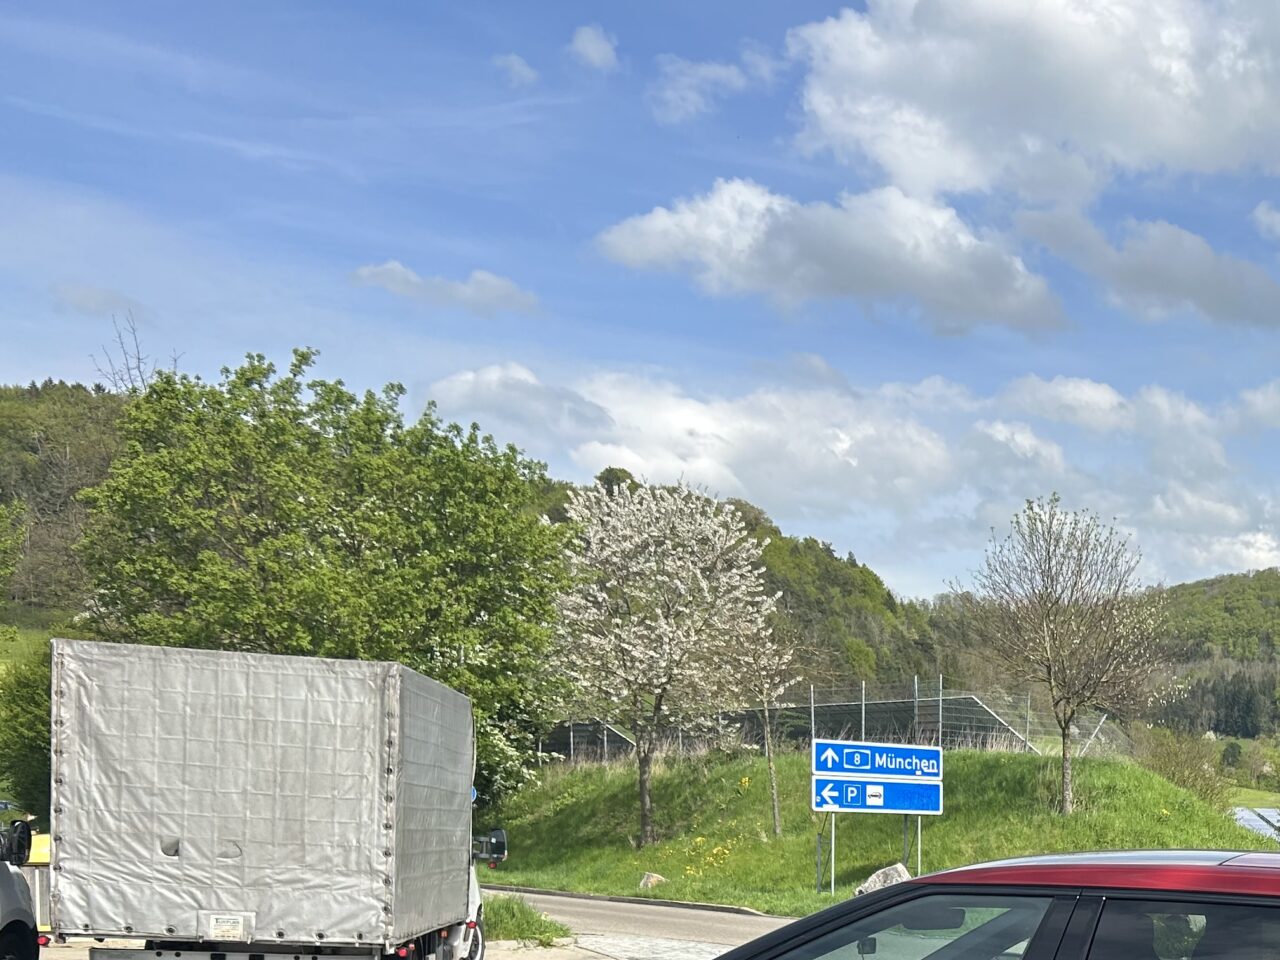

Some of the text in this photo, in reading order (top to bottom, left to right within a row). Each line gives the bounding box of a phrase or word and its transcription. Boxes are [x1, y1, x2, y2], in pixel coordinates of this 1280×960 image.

[853, 752, 938, 771] 8 München
[847, 786, 858, 803] P
